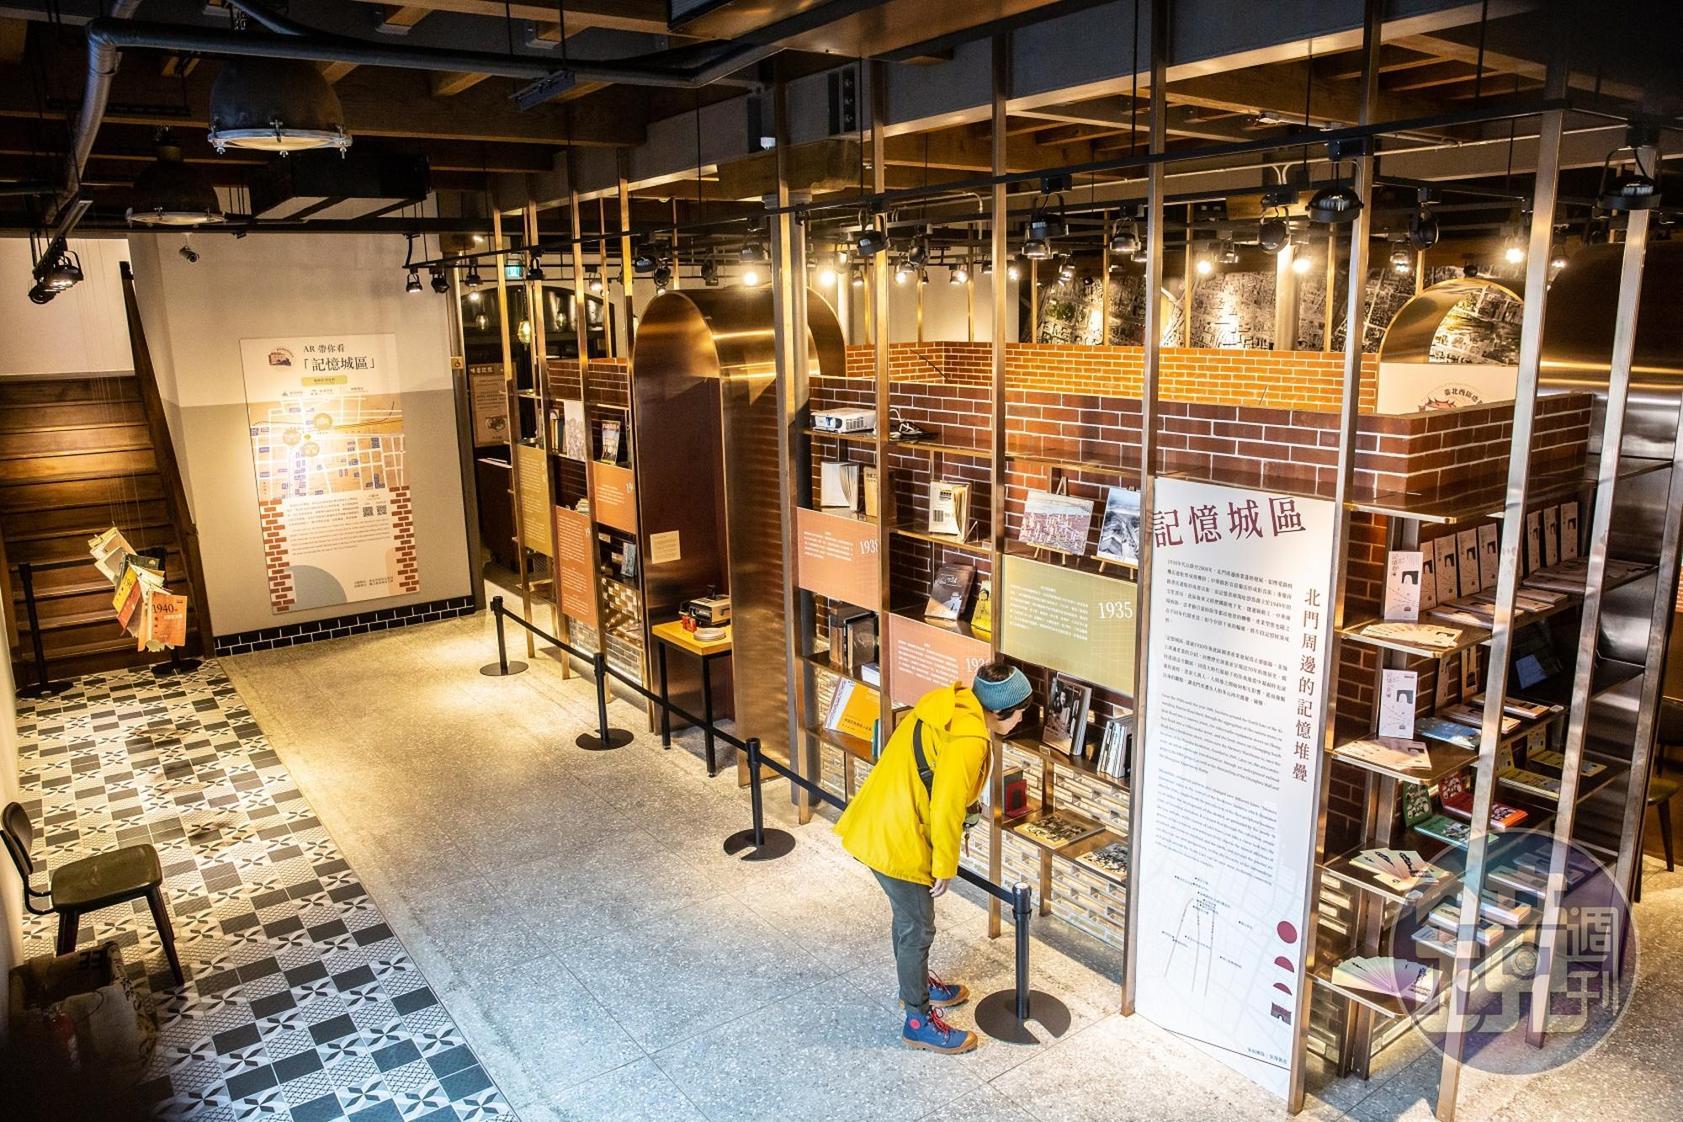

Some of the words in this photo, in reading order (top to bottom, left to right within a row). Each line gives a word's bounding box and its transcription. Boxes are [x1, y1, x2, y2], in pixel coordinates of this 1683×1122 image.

[303, 346, 315, 354] AR
[1152, 496, 1306, 549] 記憶城區
[152, 603, 174, 613] 1940
[1098, 601, 1134, 620] 1935
[1293, 587, 1321, 783] 北門周邊的記憶堆疊
